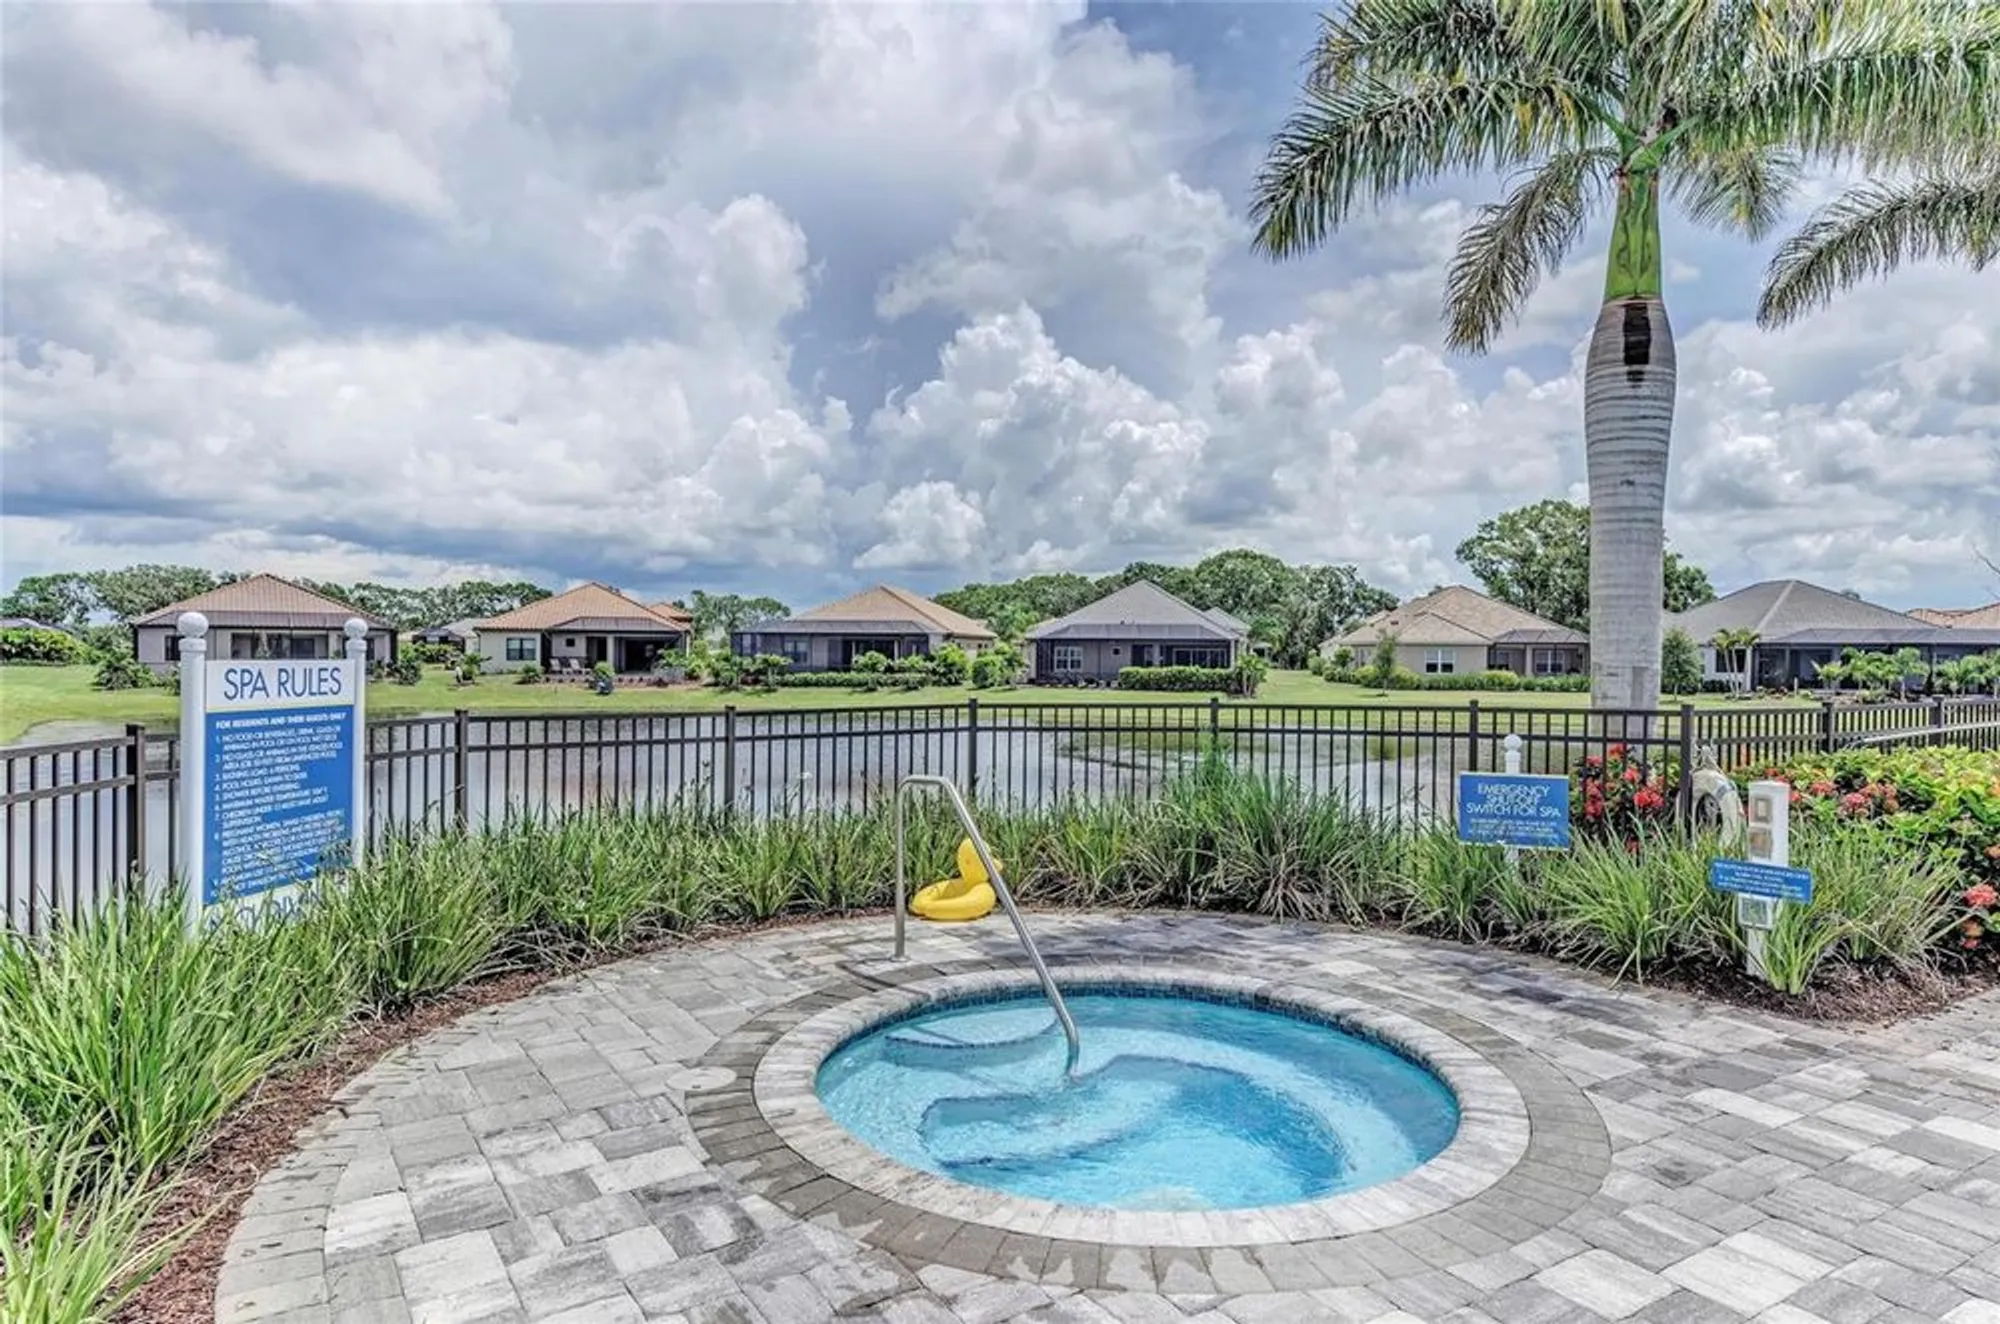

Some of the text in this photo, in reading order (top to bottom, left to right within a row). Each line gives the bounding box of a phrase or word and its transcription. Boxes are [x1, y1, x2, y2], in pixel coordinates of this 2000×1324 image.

[224, 667, 342, 700] SPA RULES
[1477, 783, 1551, 797] EMERGENCY
[1466, 802, 1561, 818] SWITCH FOR SPA
